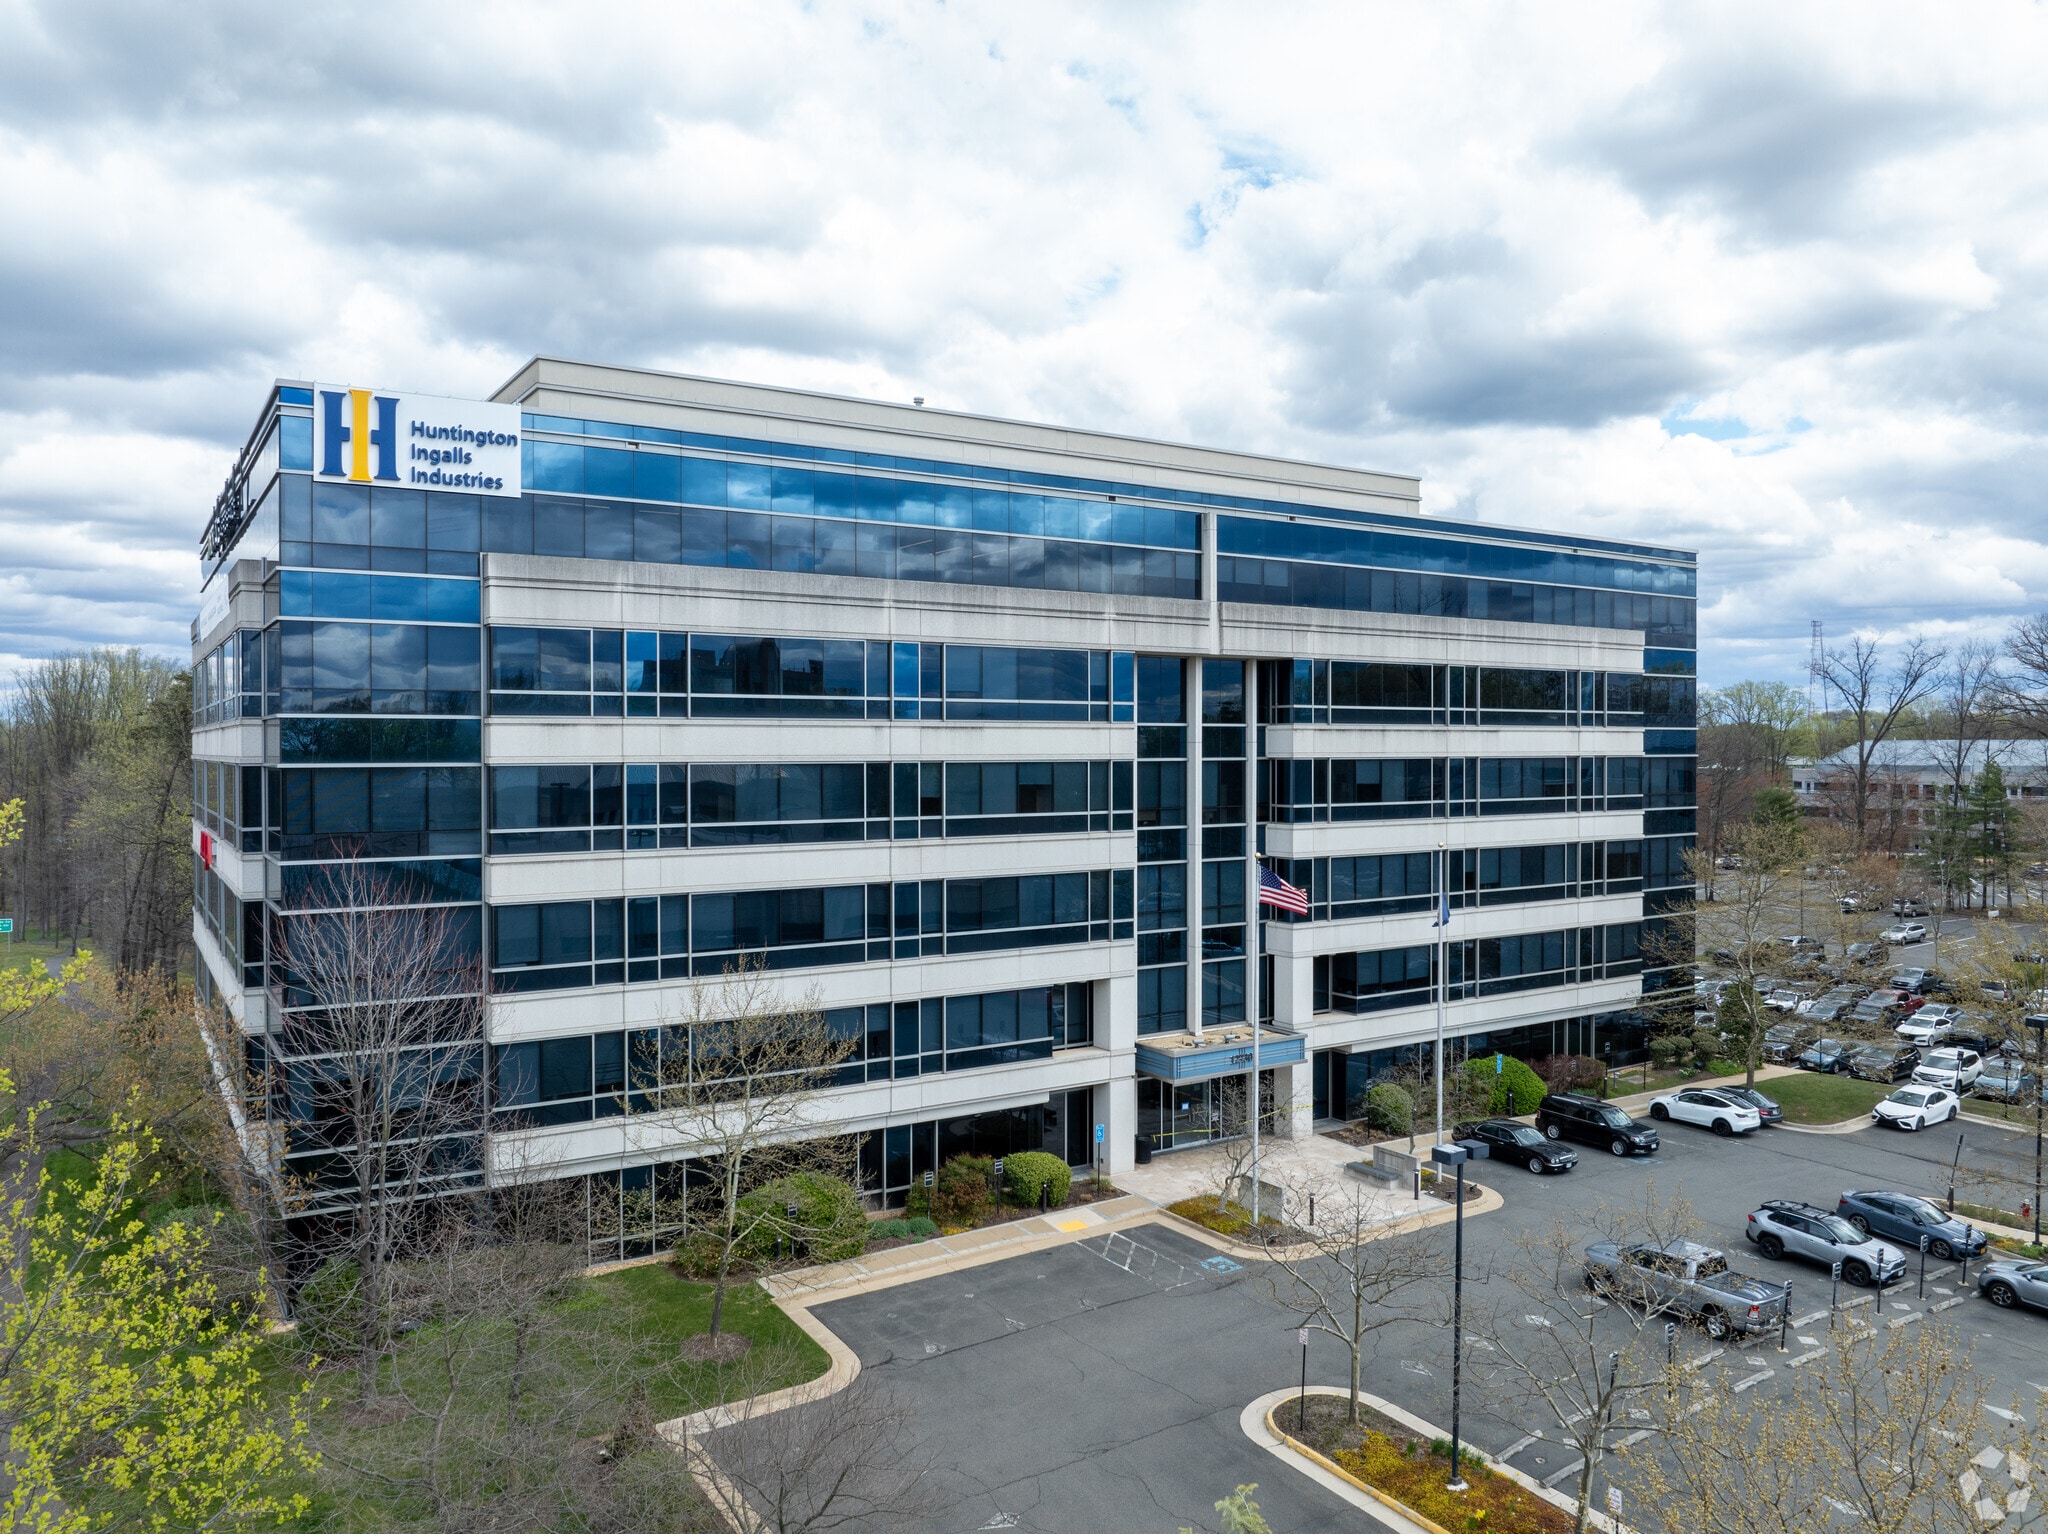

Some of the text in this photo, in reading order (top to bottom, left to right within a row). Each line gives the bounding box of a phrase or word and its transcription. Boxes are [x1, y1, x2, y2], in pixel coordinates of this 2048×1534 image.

[410, 420, 518, 448] Huntington
[410, 443, 473, 466] Ingalls
[410, 466, 504, 490] Industries
